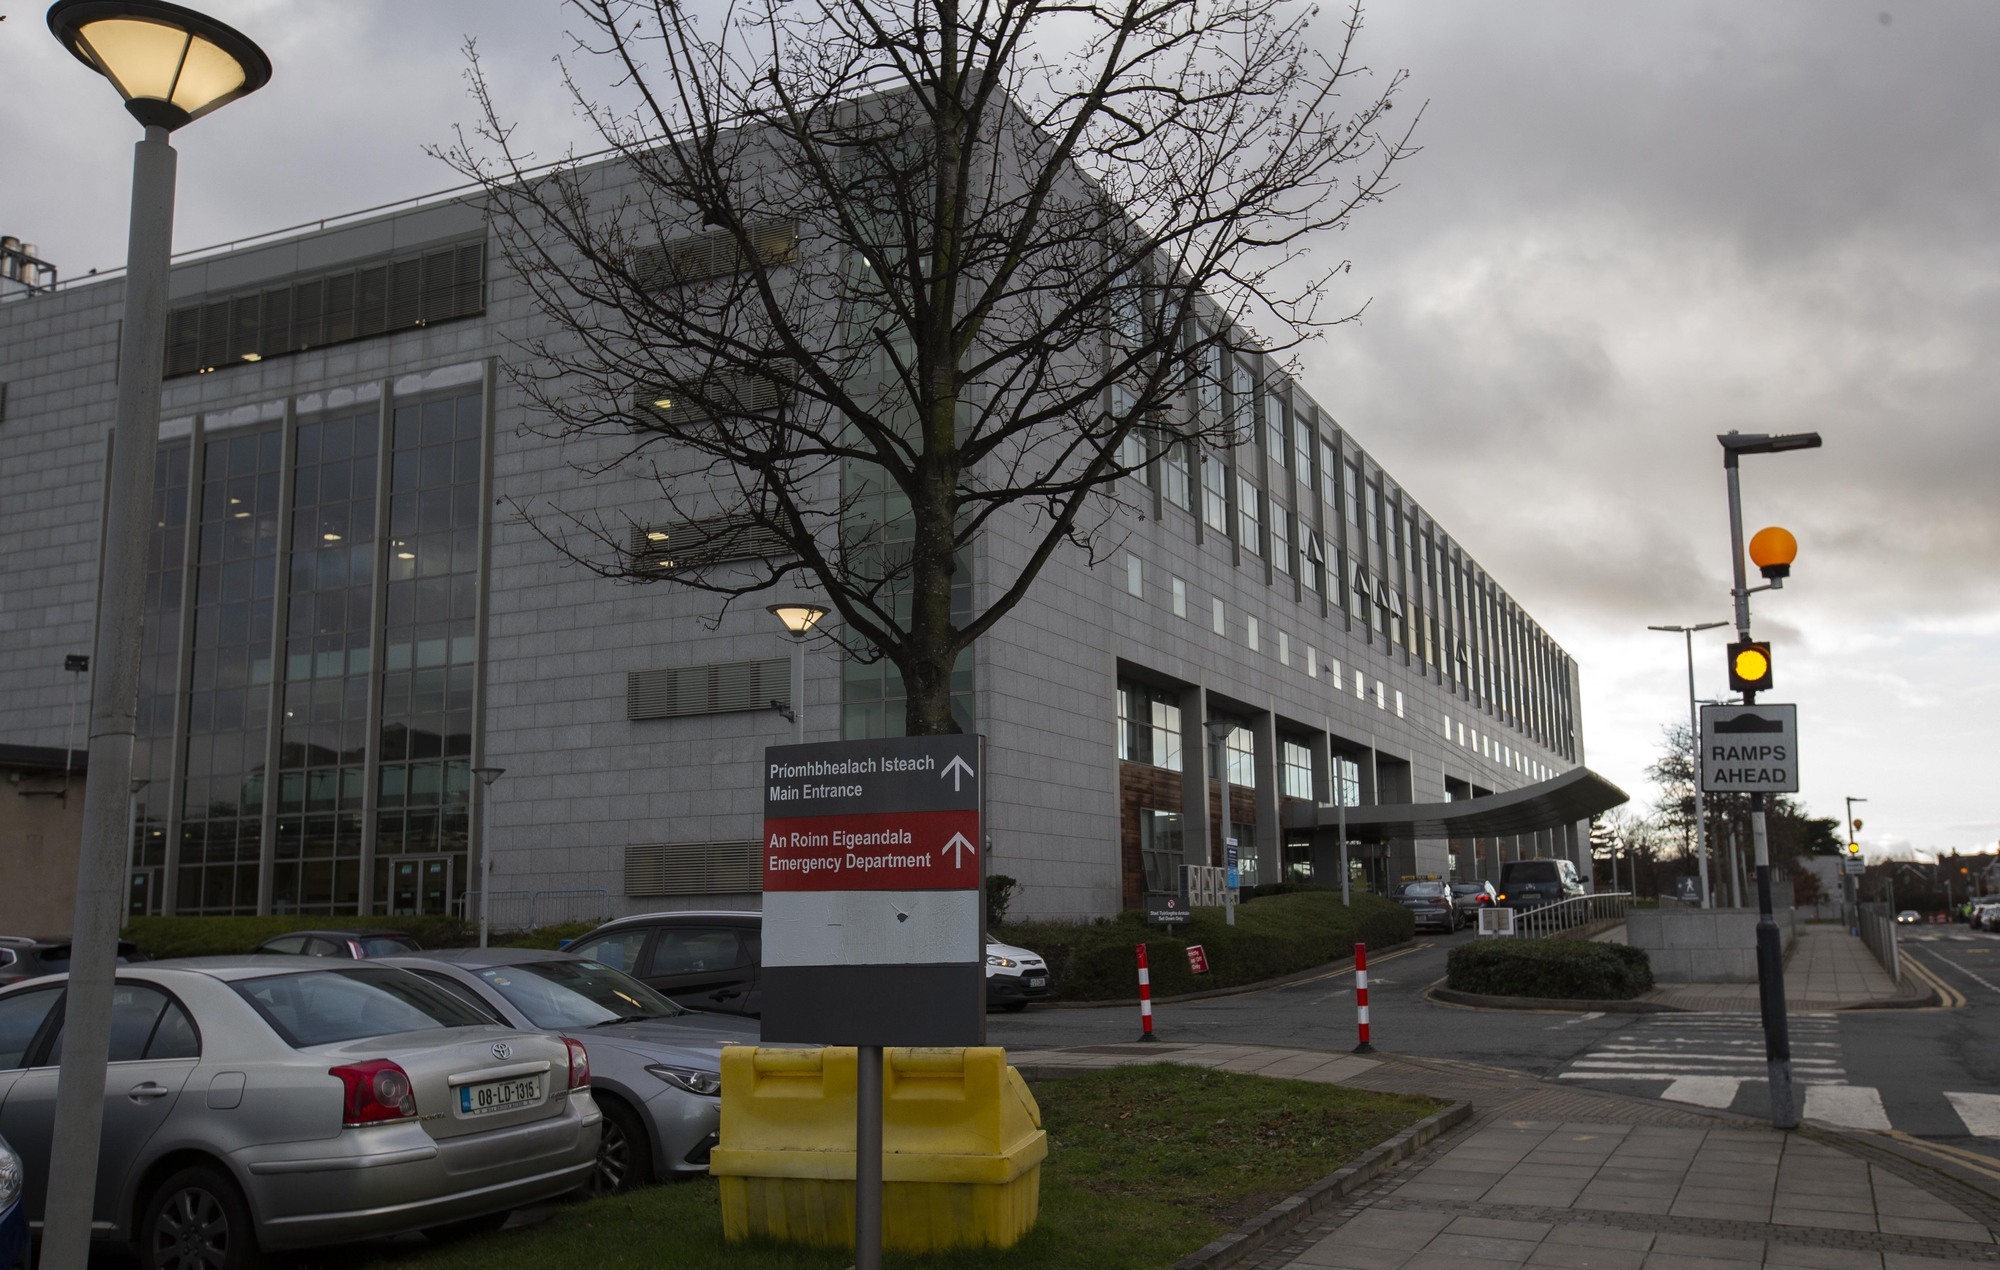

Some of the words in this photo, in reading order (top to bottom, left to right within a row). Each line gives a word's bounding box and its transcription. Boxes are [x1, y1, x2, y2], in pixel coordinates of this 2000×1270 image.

[1712, 745, 1786, 761] RAMPS
[770, 758, 876, 779] Príomhbhealach
[881, 754, 935, 772] Isteach
[1714, 768, 1786, 783] AHEAD
[769, 786, 799, 802] Main
[803, 783, 863, 800] Entrance
[769, 833, 787, 848] An
[790, 831, 829, 848] Roinn
[832, 829, 912, 850] Eigeandala
[769, 855, 842, 874] Emergency
[846, 852, 931, 873] Department
[478, 1081, 534, 1107] 08-LD-1315
